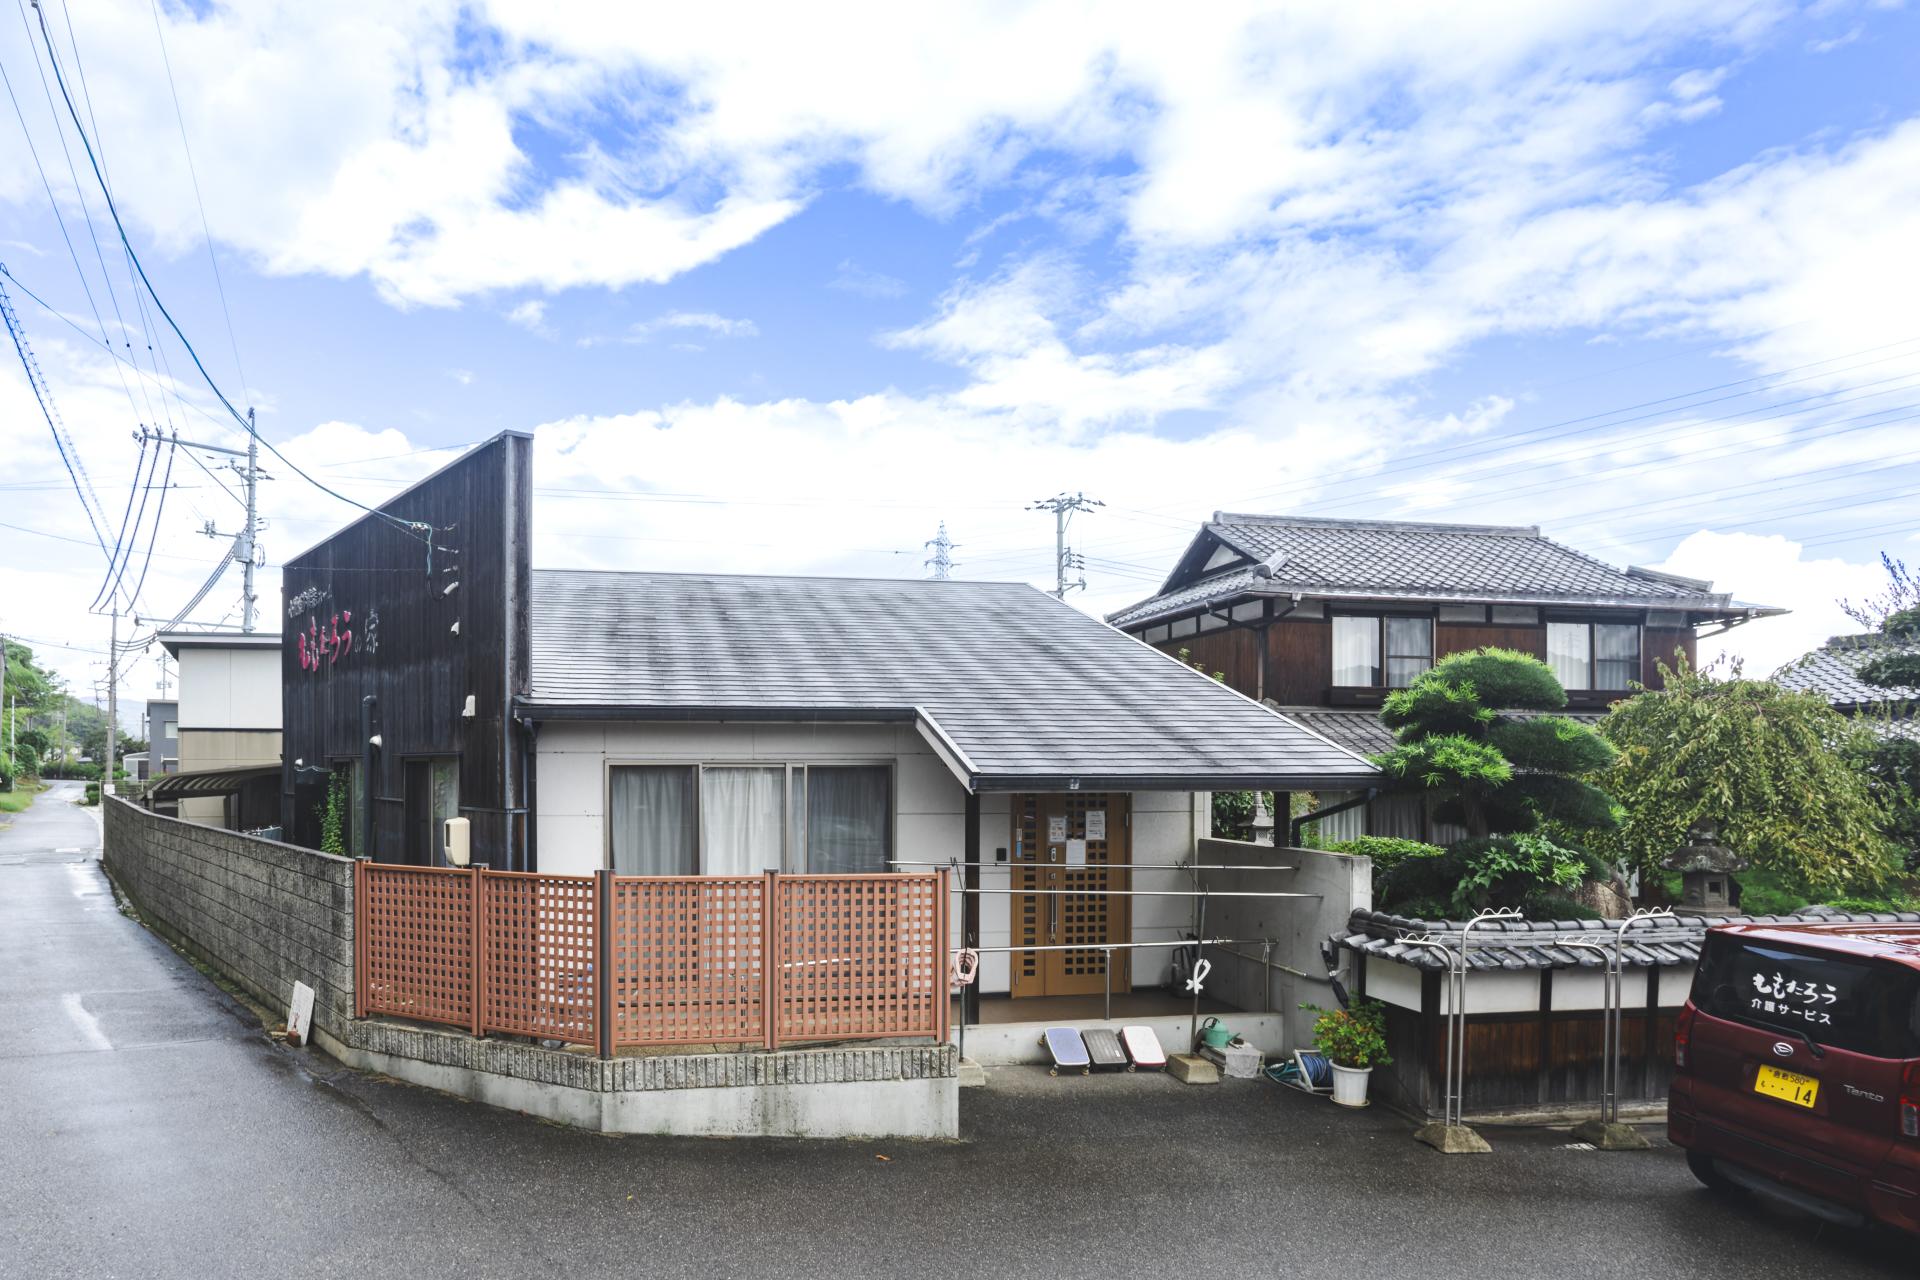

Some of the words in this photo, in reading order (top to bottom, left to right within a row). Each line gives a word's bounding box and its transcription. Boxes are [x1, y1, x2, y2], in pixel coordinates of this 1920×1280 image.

[1752, 972, 1837, 1005] ももたろう
[1751, 998, 1832, 1025] 介護サービス
[1843, 1084, 1885, 1103] Tanto
